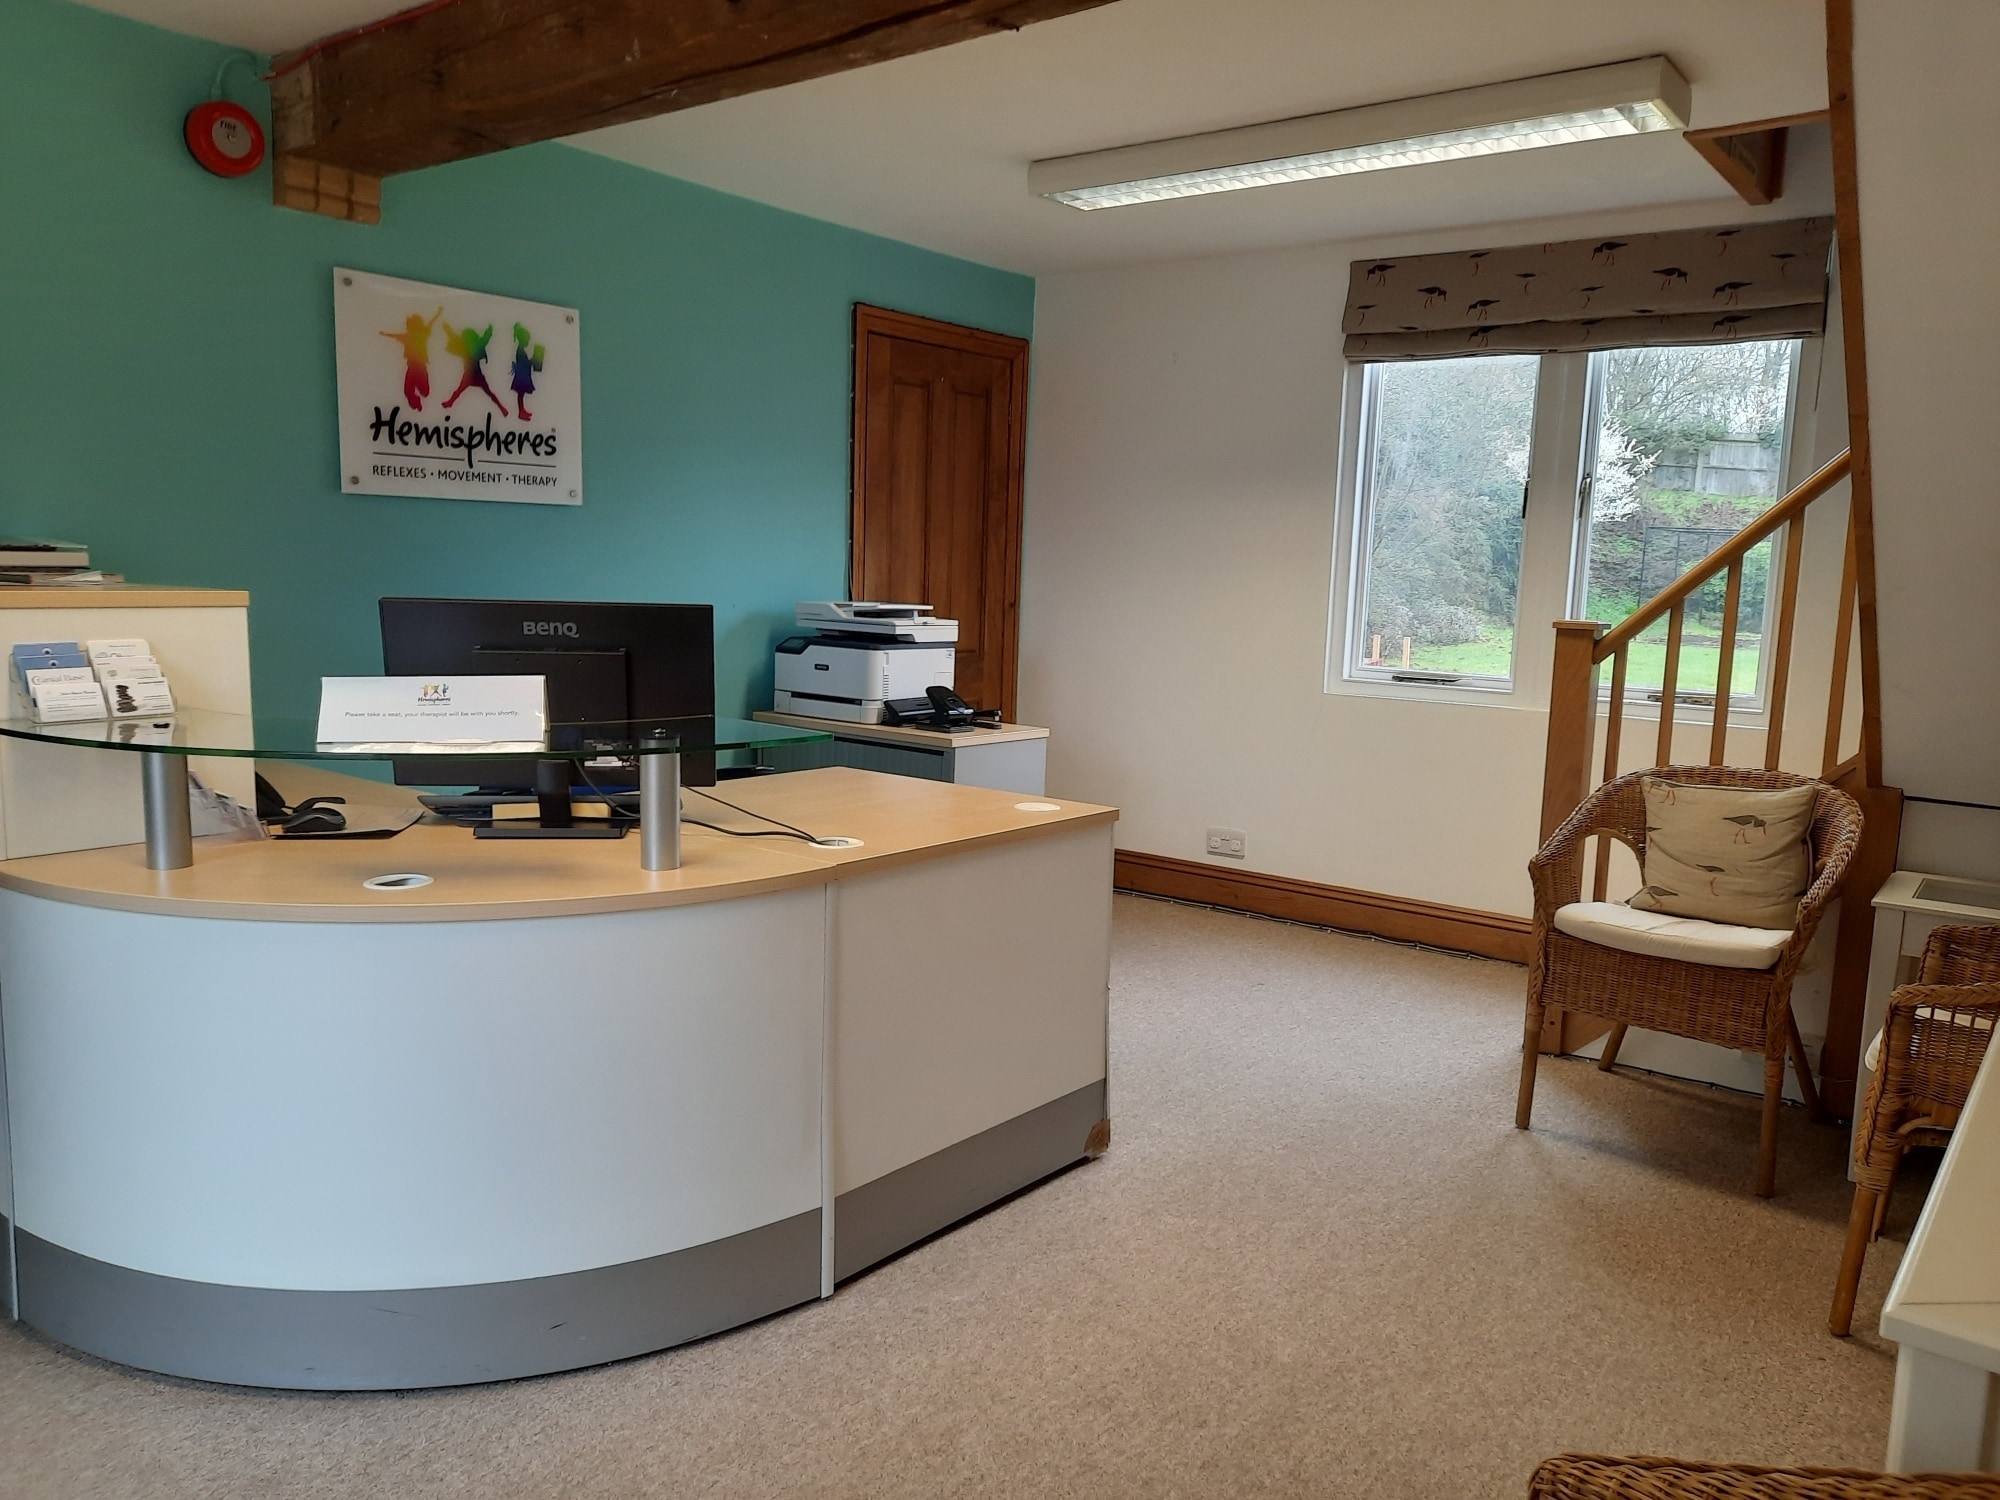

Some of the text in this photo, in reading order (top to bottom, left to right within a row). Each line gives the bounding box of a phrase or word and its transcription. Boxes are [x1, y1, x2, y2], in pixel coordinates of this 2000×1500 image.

[370, 406, 557, 469] Hemispheres
[372, 465, 558, 487] REFLEXES MOVEMENT THERAPY
[522, 621, 580, 638] BenQ
